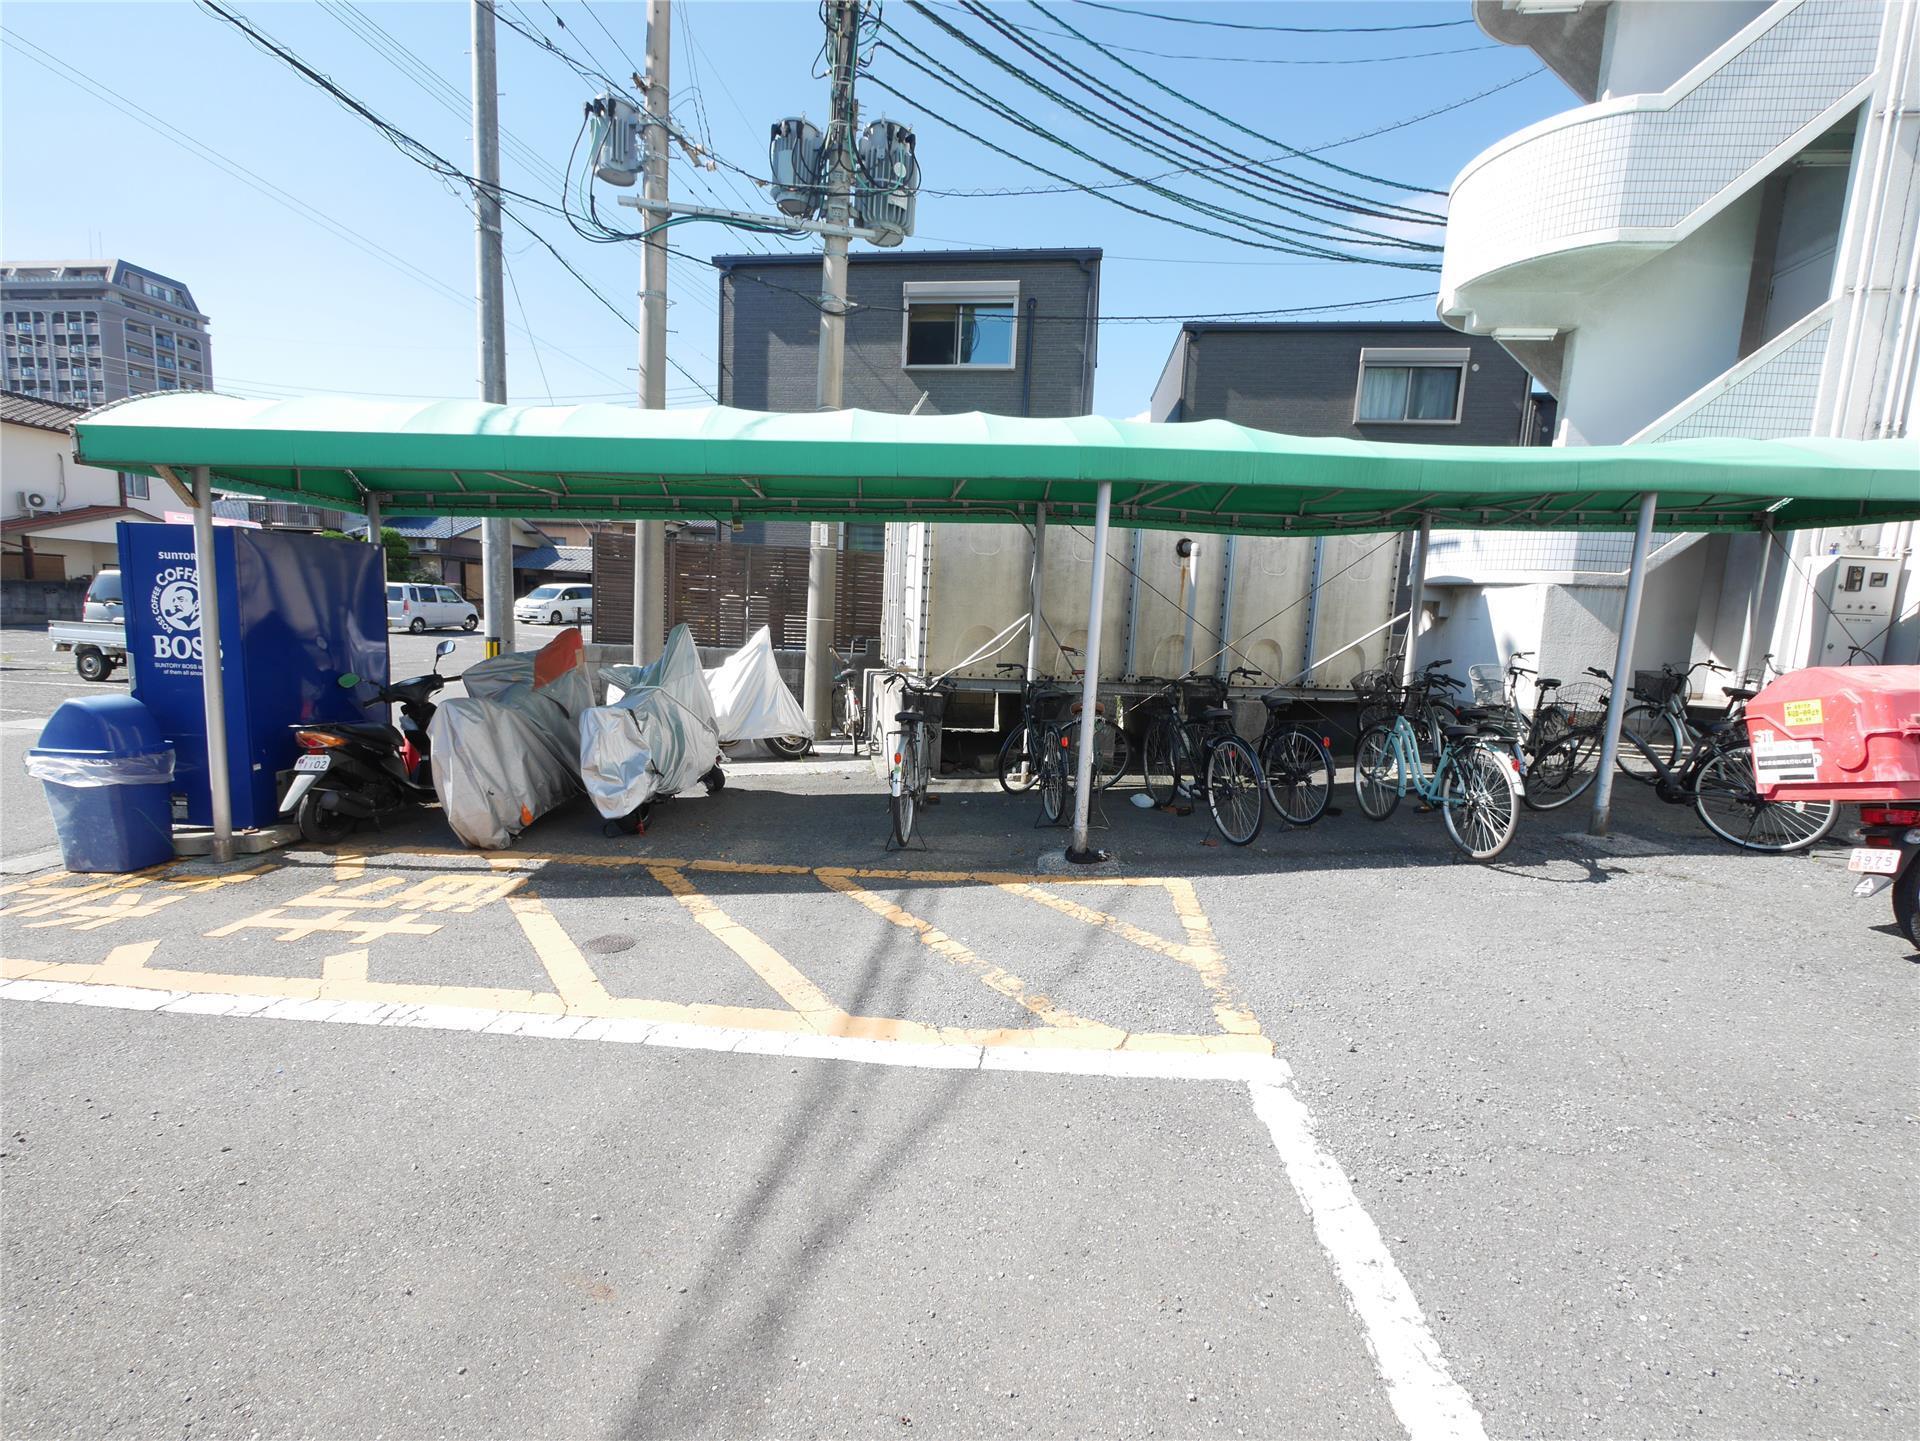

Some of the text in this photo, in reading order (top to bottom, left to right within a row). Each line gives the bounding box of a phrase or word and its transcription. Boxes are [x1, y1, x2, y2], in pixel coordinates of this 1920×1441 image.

[158, 551, 197, 560] SUNTOR
[156, 566, 199, 586] COFFE
[151, 587, 174, 634] BOSS COFFEE
